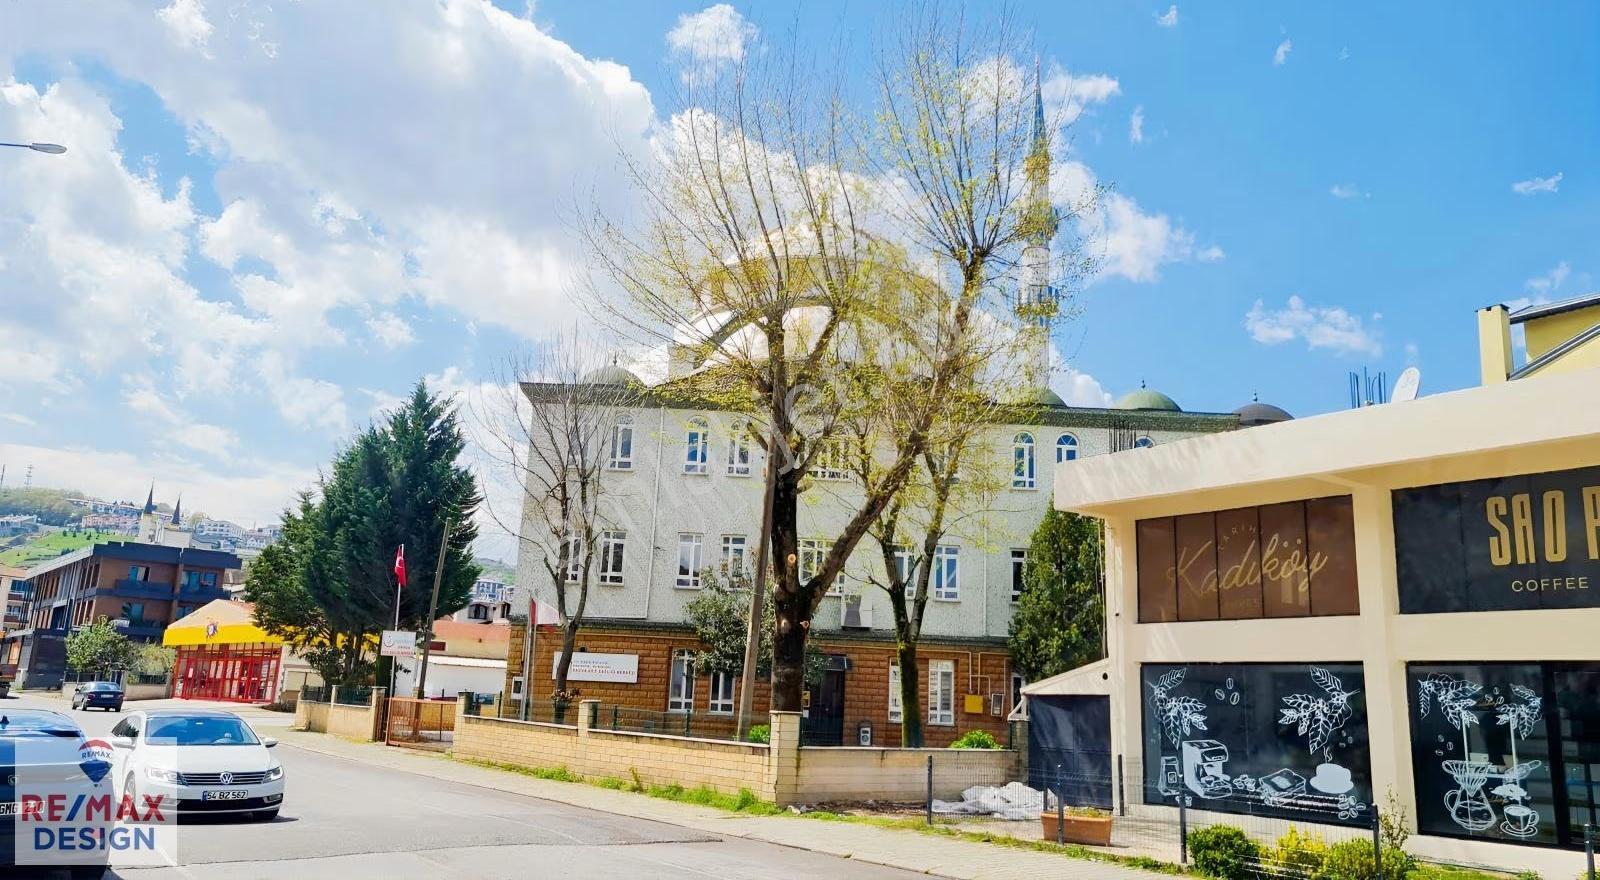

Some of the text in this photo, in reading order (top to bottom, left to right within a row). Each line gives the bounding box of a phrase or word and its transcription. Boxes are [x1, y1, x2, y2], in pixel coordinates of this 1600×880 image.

[1486, 490, 1567, 566] SAO
[1167, 532, 1328, 597] Kadıköy
[1511, 577, 1589, 592] COFFEE
